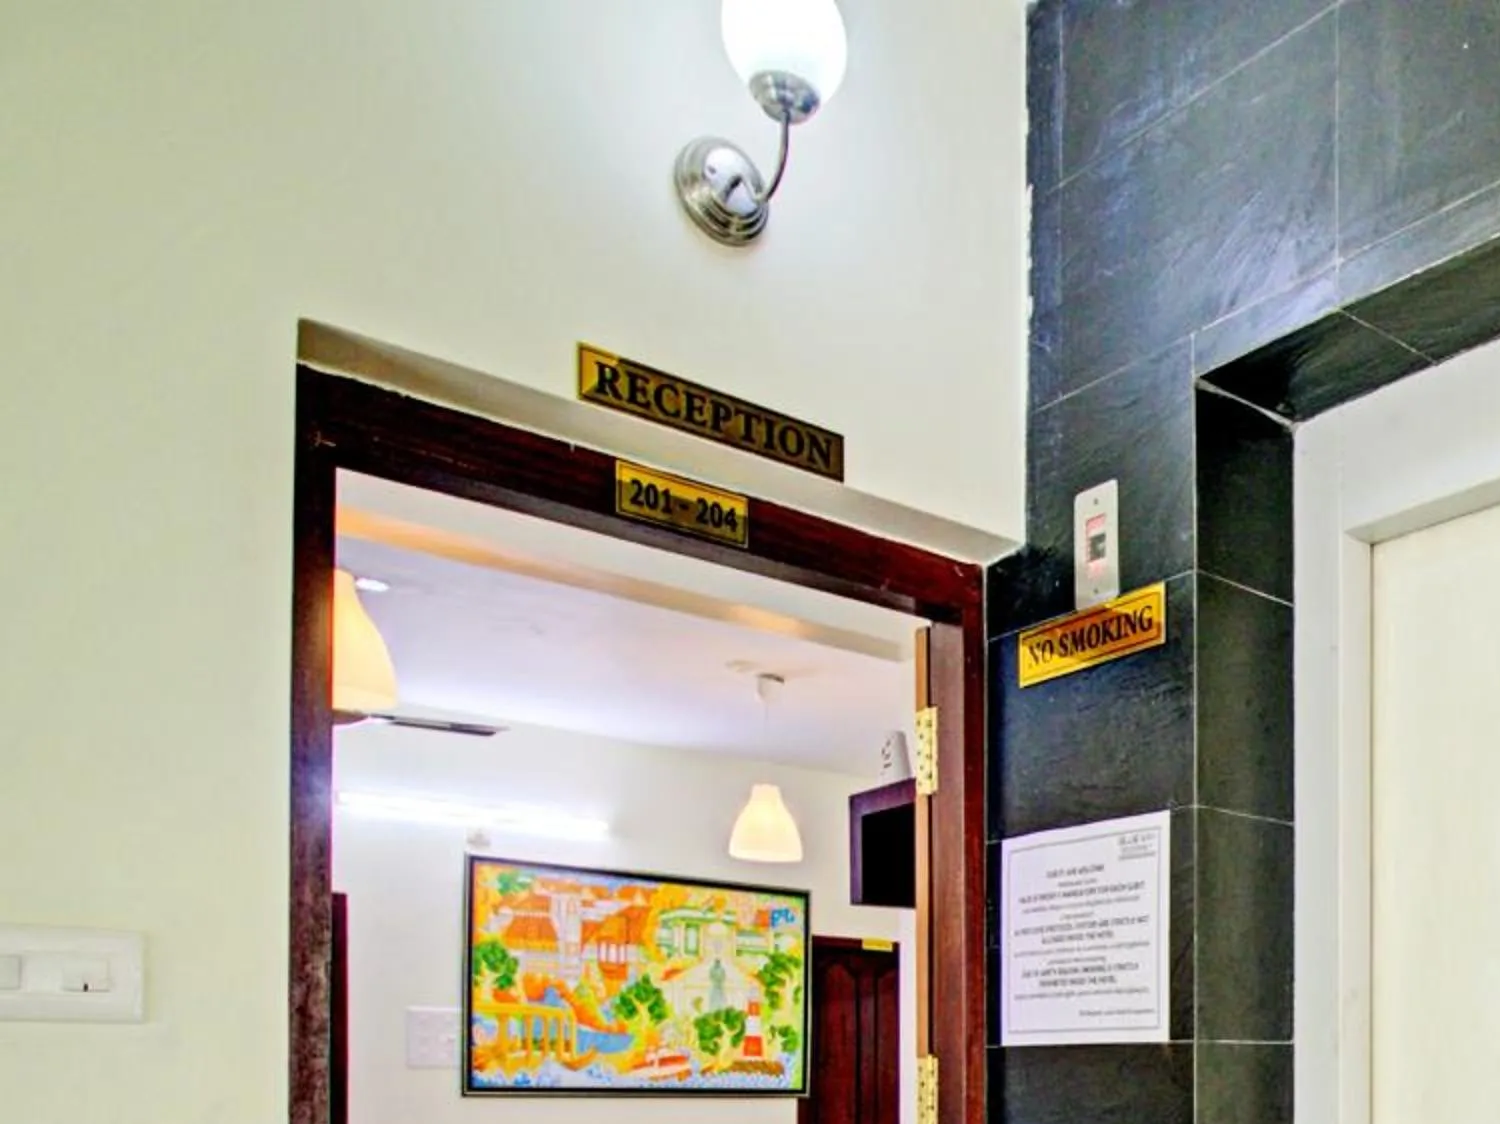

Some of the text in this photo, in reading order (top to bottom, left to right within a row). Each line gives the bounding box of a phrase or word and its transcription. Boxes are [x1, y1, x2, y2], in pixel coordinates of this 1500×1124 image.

[594, 361, 834, 471] RECEPTION
[1028, 605, 1153, 668] NO SMOKING
